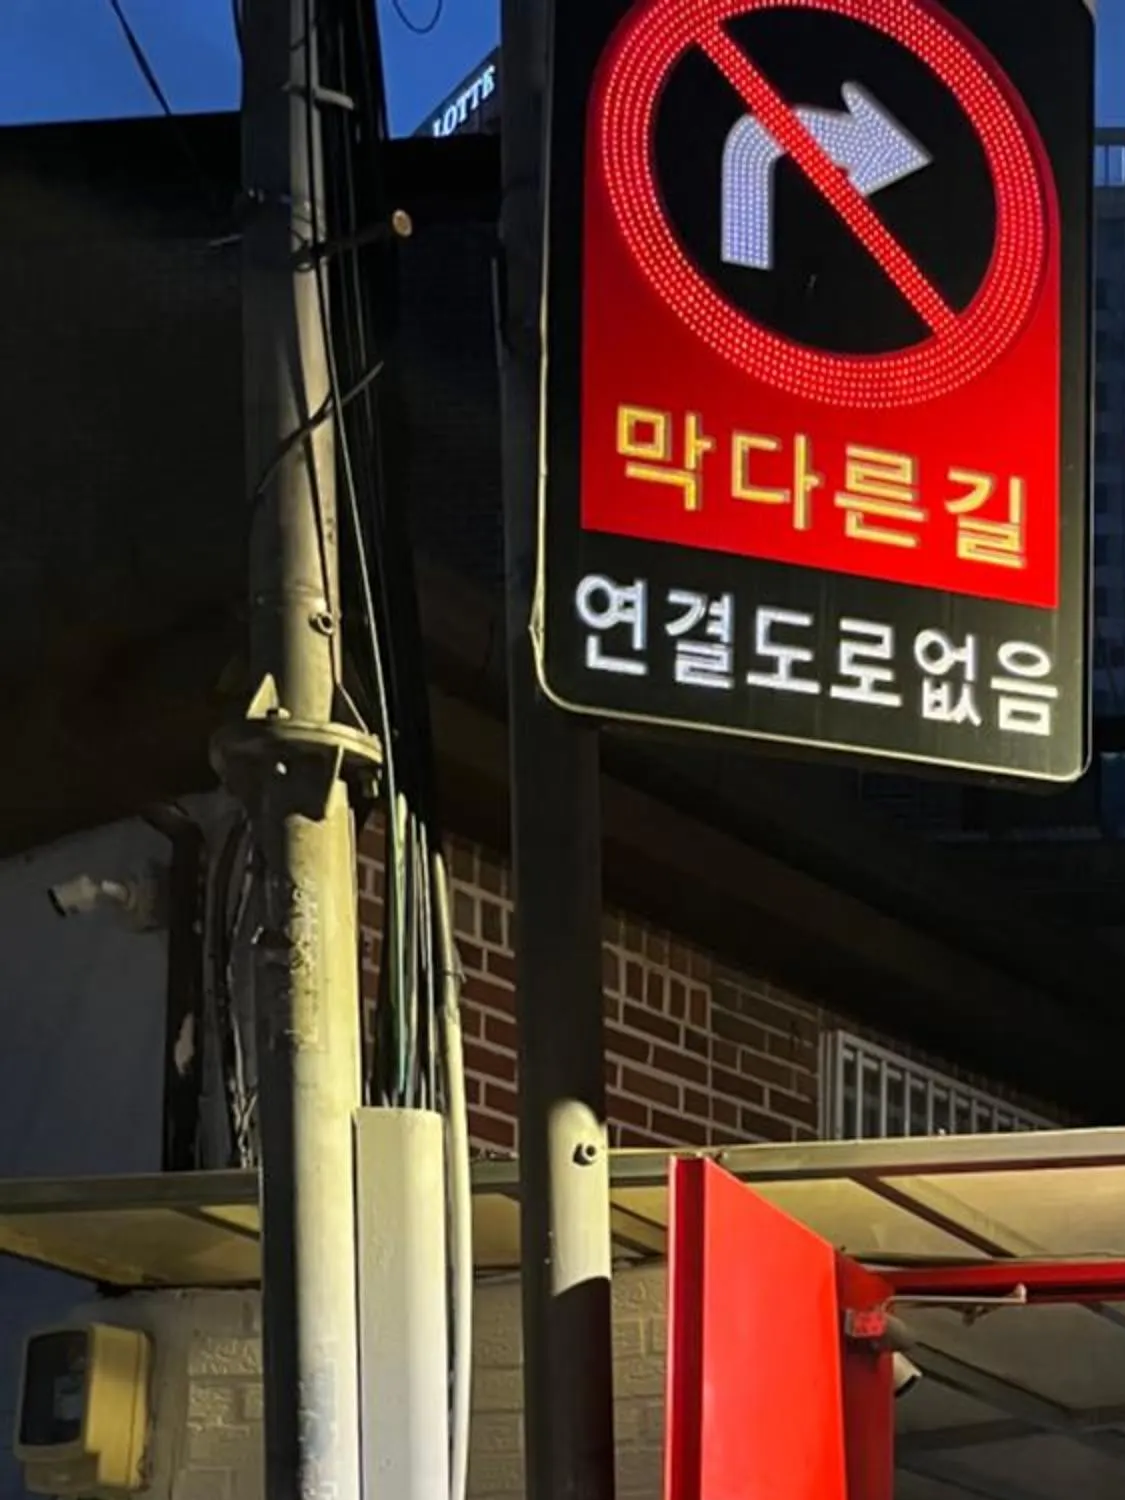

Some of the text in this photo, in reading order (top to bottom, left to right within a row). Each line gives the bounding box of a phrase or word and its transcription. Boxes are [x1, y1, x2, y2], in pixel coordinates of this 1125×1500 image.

[433, 65, 496, 137] LOTTE
[617, 404, 1027, 569] 막다른길
[575, 574, 1058, 736] 연결도로없음
